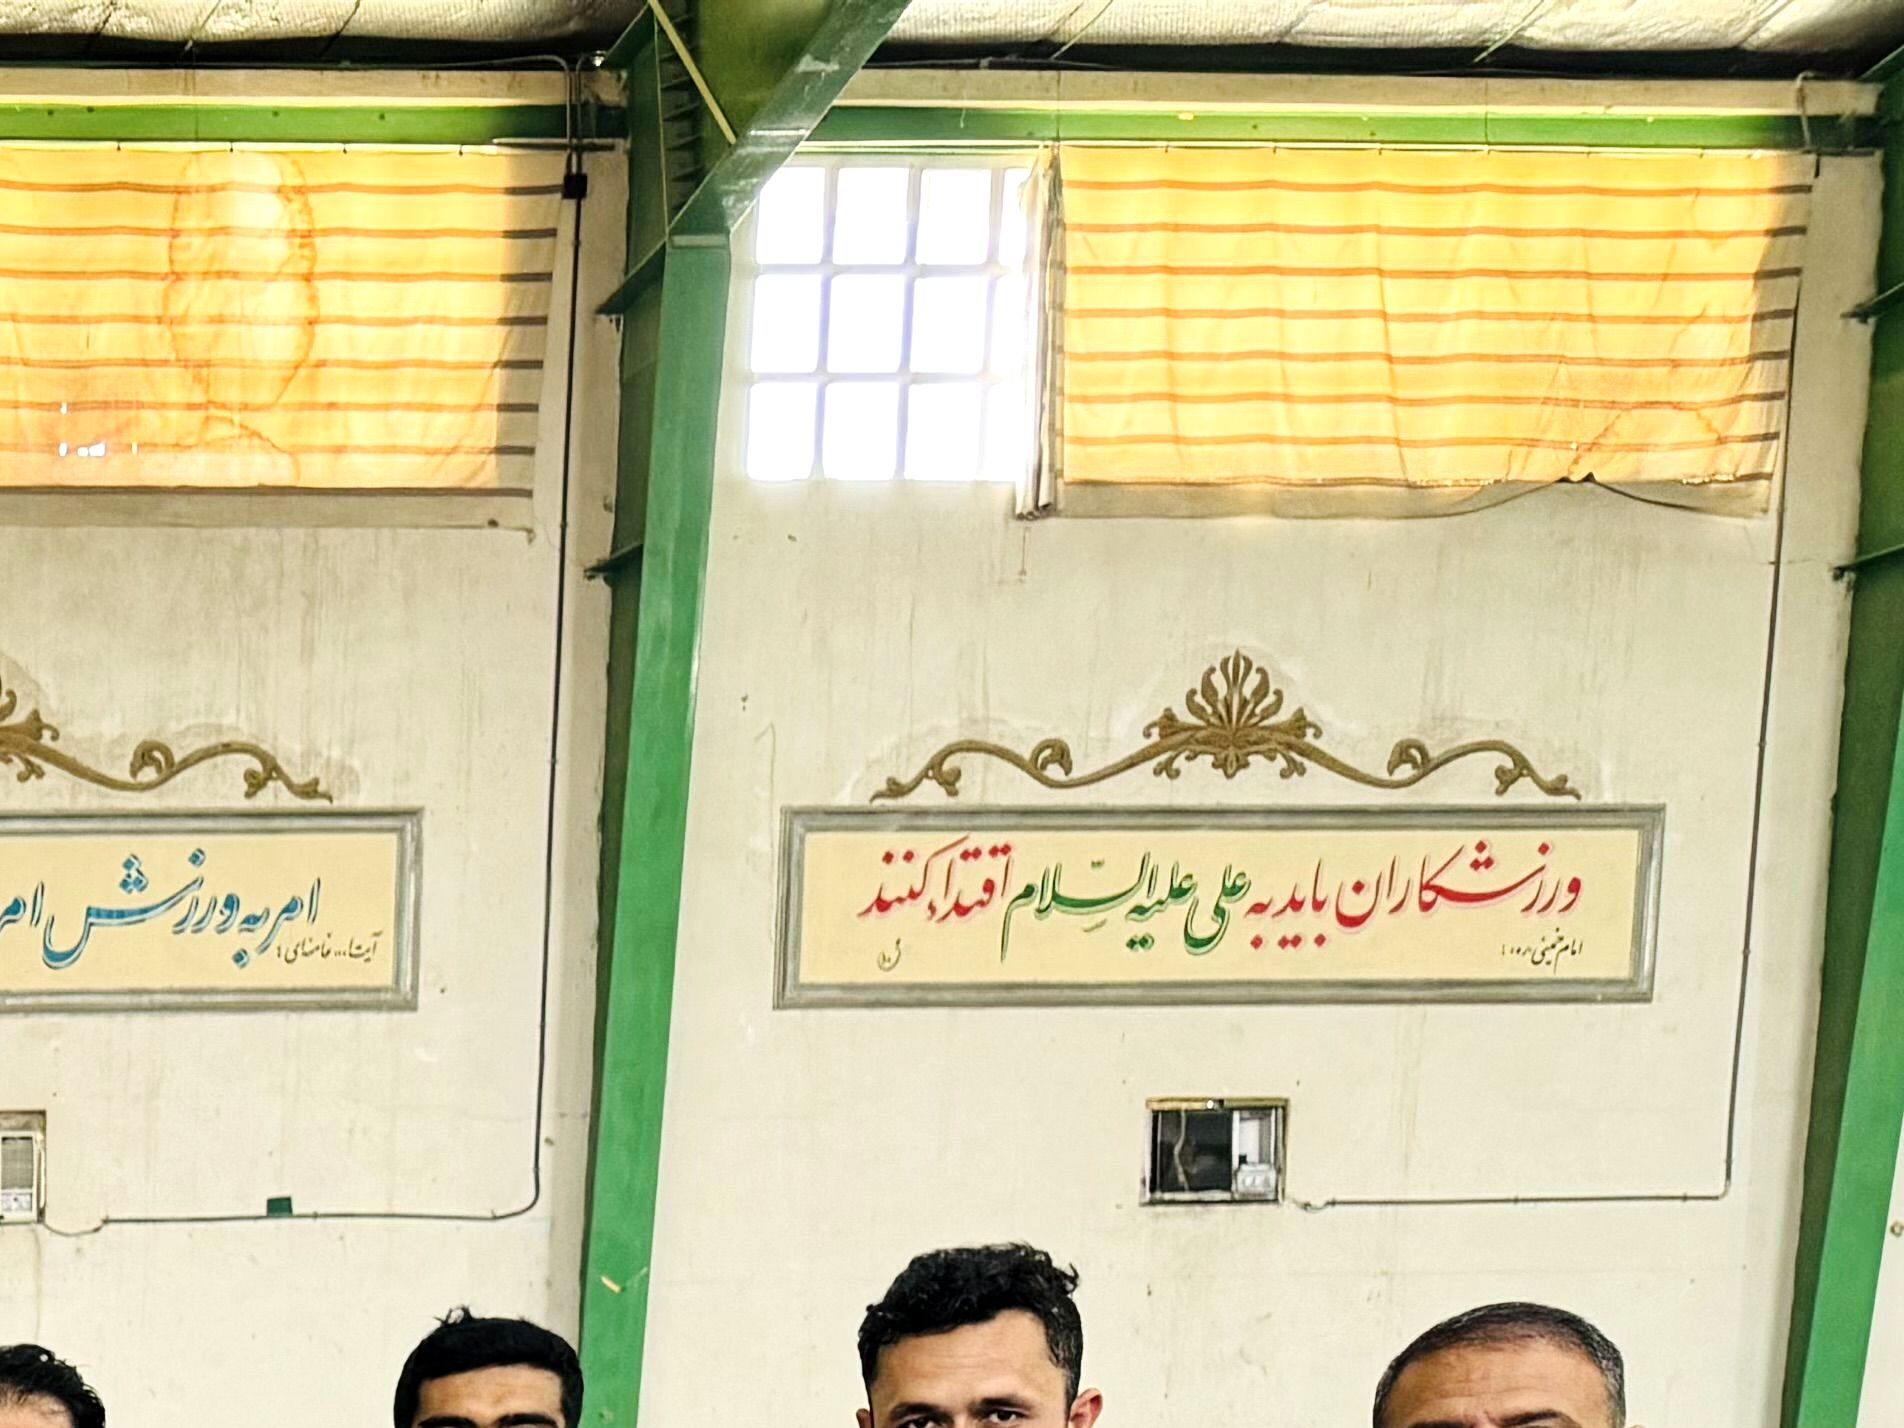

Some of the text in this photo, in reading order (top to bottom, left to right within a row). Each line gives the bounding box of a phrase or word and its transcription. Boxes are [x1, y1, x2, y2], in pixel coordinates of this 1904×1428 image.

[43, 847, 241, 970] ورزش
[257, 877, 322, 955] امر
[857, 834, 971, 919] کنند
[1124, 859, 1198, 951] علیه
[1183, 862, 1252, 956] علی
[1272, 857, 1330, 950] باید
[1335, 840, 1584, 931] ورزشکاران
[232, 905, 270, 969] به
[1244, 895, 1274, 951] به
